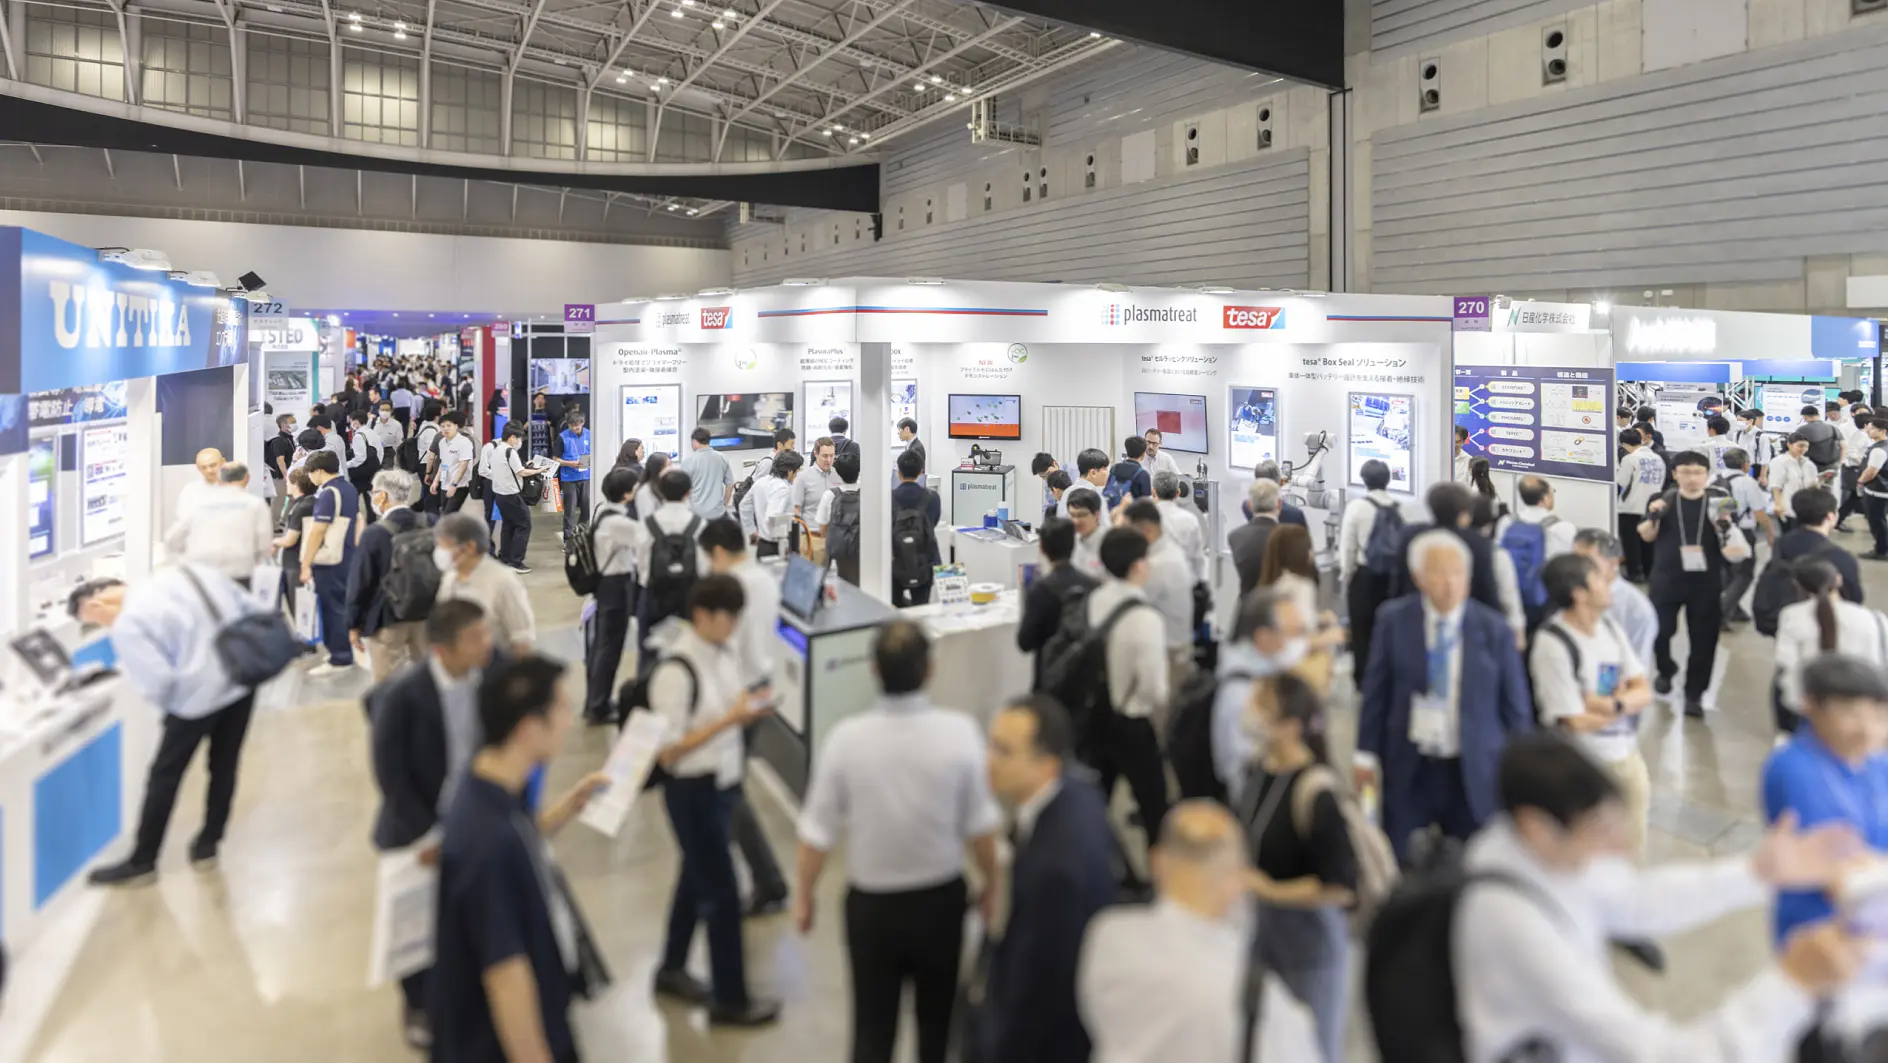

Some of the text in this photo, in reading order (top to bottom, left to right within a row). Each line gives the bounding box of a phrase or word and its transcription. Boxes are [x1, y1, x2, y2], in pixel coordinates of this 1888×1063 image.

[253, 302, 283, 314] 272
[568, 308, 591, 319] 271
[1457, 301, 1485, 314] 270
[702, 310, 724, 327] tesa
[1124, 305, 1197, 325] plasmatreat
[1226, 307, 1269, 326] tesa
[1522, 311, 1576, 325] 日産化学株式会社
[1322, 358, 1337, 366] Box
[1338, 358, 1355, 366] Seal
[1356, 358, 1407, 368] ソリューション
[968, 482, 997, 490] plasmatreat
